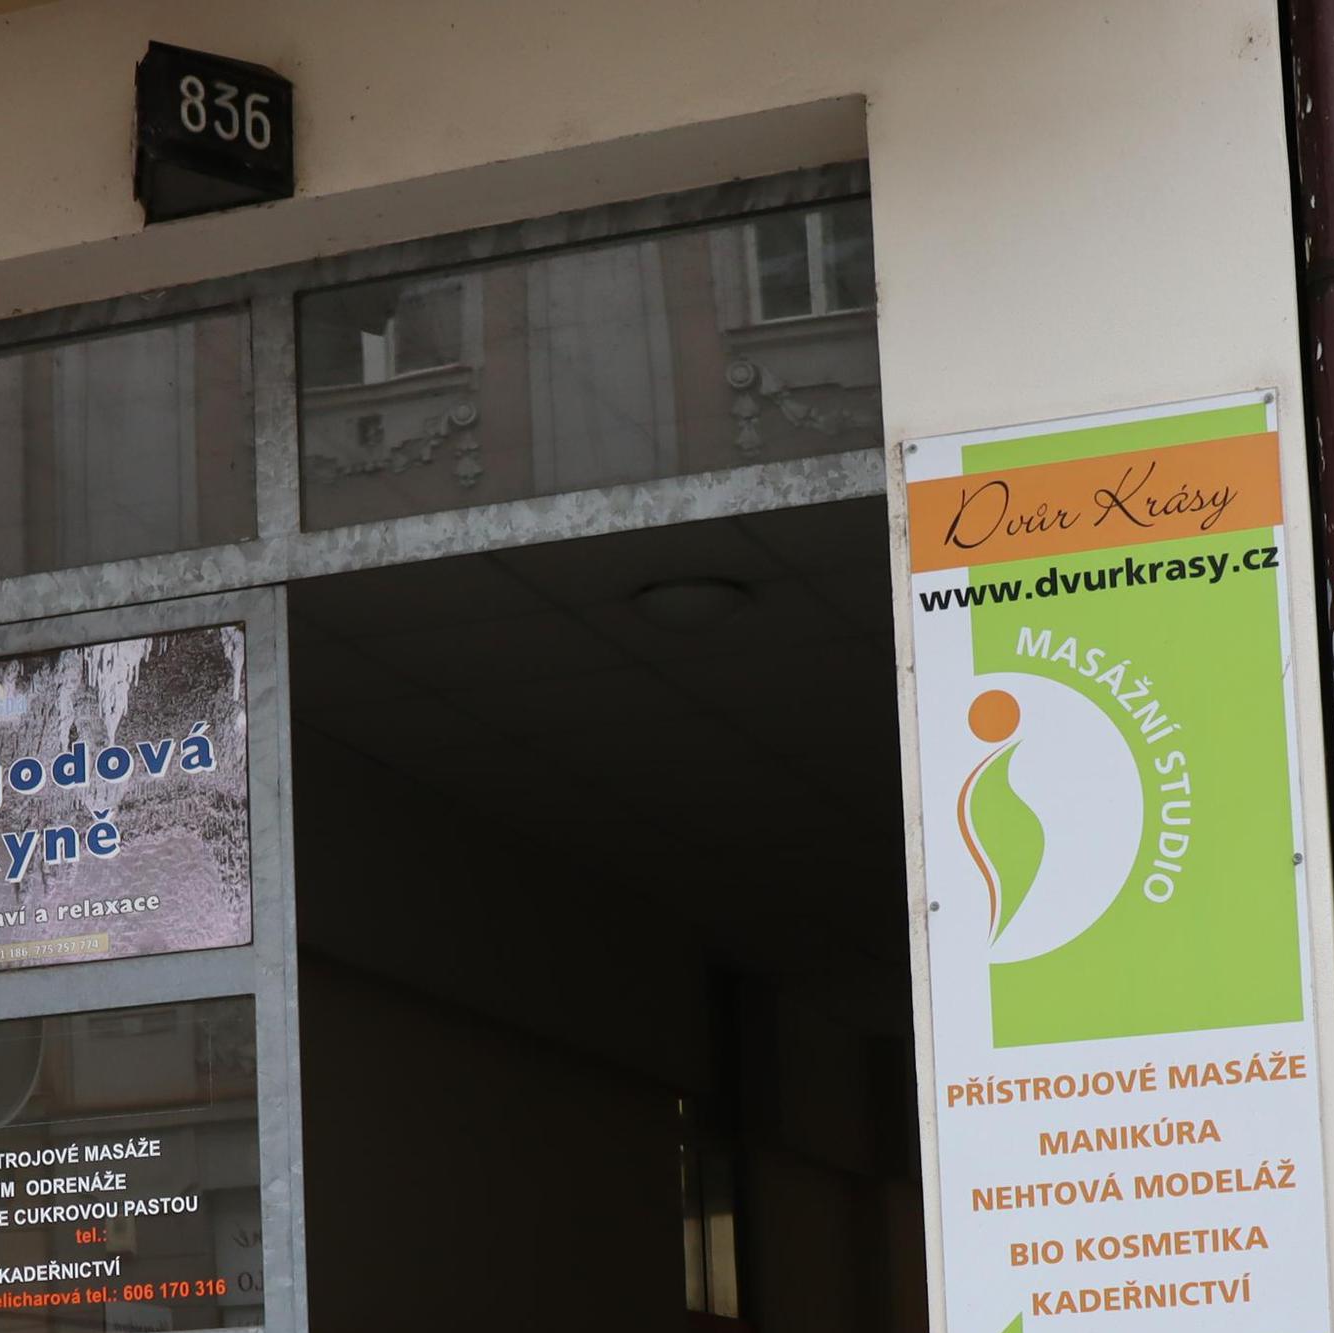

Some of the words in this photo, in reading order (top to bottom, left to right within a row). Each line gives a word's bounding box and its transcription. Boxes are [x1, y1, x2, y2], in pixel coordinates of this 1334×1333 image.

[179, 74, 271, 150] 836
[943, 479, 1081, 550] Dvůr
[1093, 460, 1238, 532] Krásy
[919, 545, 1280, 613] www.dvurkrasy.cz
[1016, 626, 1182, 745] MASÁŽNÍ
[1143, 749, 1193, 904] STUDIO
[34, 909, 49, 924] a
[57, 892, 161, 921] relaxace
[35, 942, 54, 956] 775
[946, 1061, 1157, 1108] PŘÍSTROJOVÉ
[1167, 1052, 1308, 1091] MASÁŽE
[84, 1139, 162, 1163] MASÁŽE
[1038, 1117, 1222, 1157] MANIKÚRA
[26, 1172, 127, 1197] ODRENÁŽE
[971, 1172, 1123, 1212] NEHTOVÁ
[1134, 1158, 1297, 1200] MODELÁŽ
[14, 1201, 119, 1227] CUKROVOU
[124, 1195, 199, 1218] PASTOU
[75, 1228, 108, 1244] tel.:
[1010, 1239, 1064, 1267] BIO
[1075, 1225, 1269, 1264] KOSMETIKA
[86, 1286, 117, 1304] tel.:
[123, 1283, 154, 1300] 606
[159, 1281, 190, 1297] 170
[195, 1278, 227, 1296] 316
[1031, 1273, 1251, 1316] KADEŘNICTVÍ
